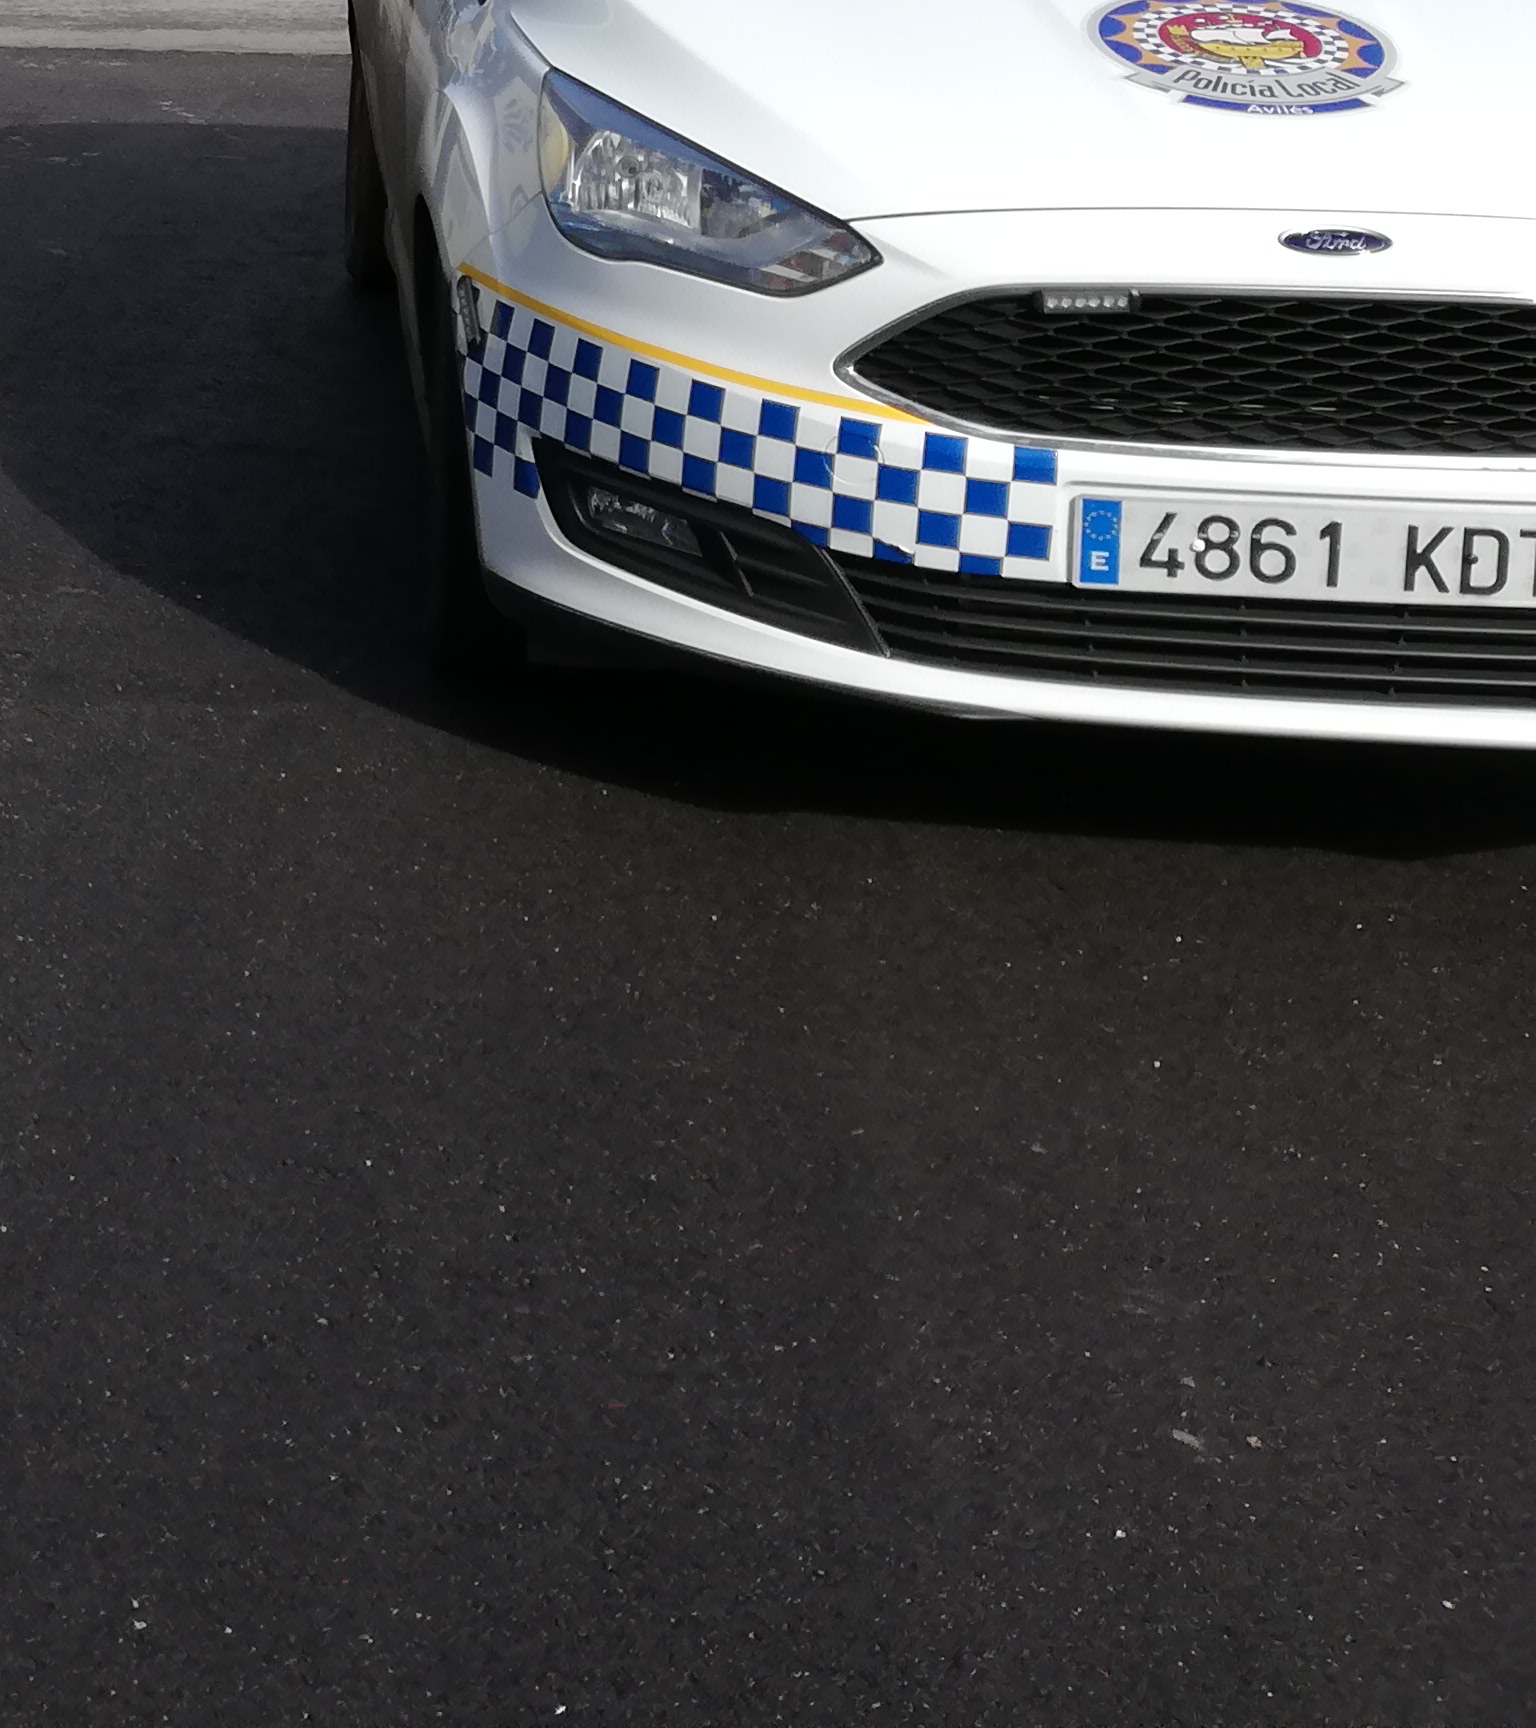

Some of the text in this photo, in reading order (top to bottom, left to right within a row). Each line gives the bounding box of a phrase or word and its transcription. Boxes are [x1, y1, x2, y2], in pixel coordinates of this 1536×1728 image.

[1172, 69, 1362, 98] Policía Local
[1246, 104, 1314, 116] Avilés
[1305, 230, 1368, 251] Ford
[1089, 550, 1109, 571] E
[1139, 511, 1343, 588] 4861
